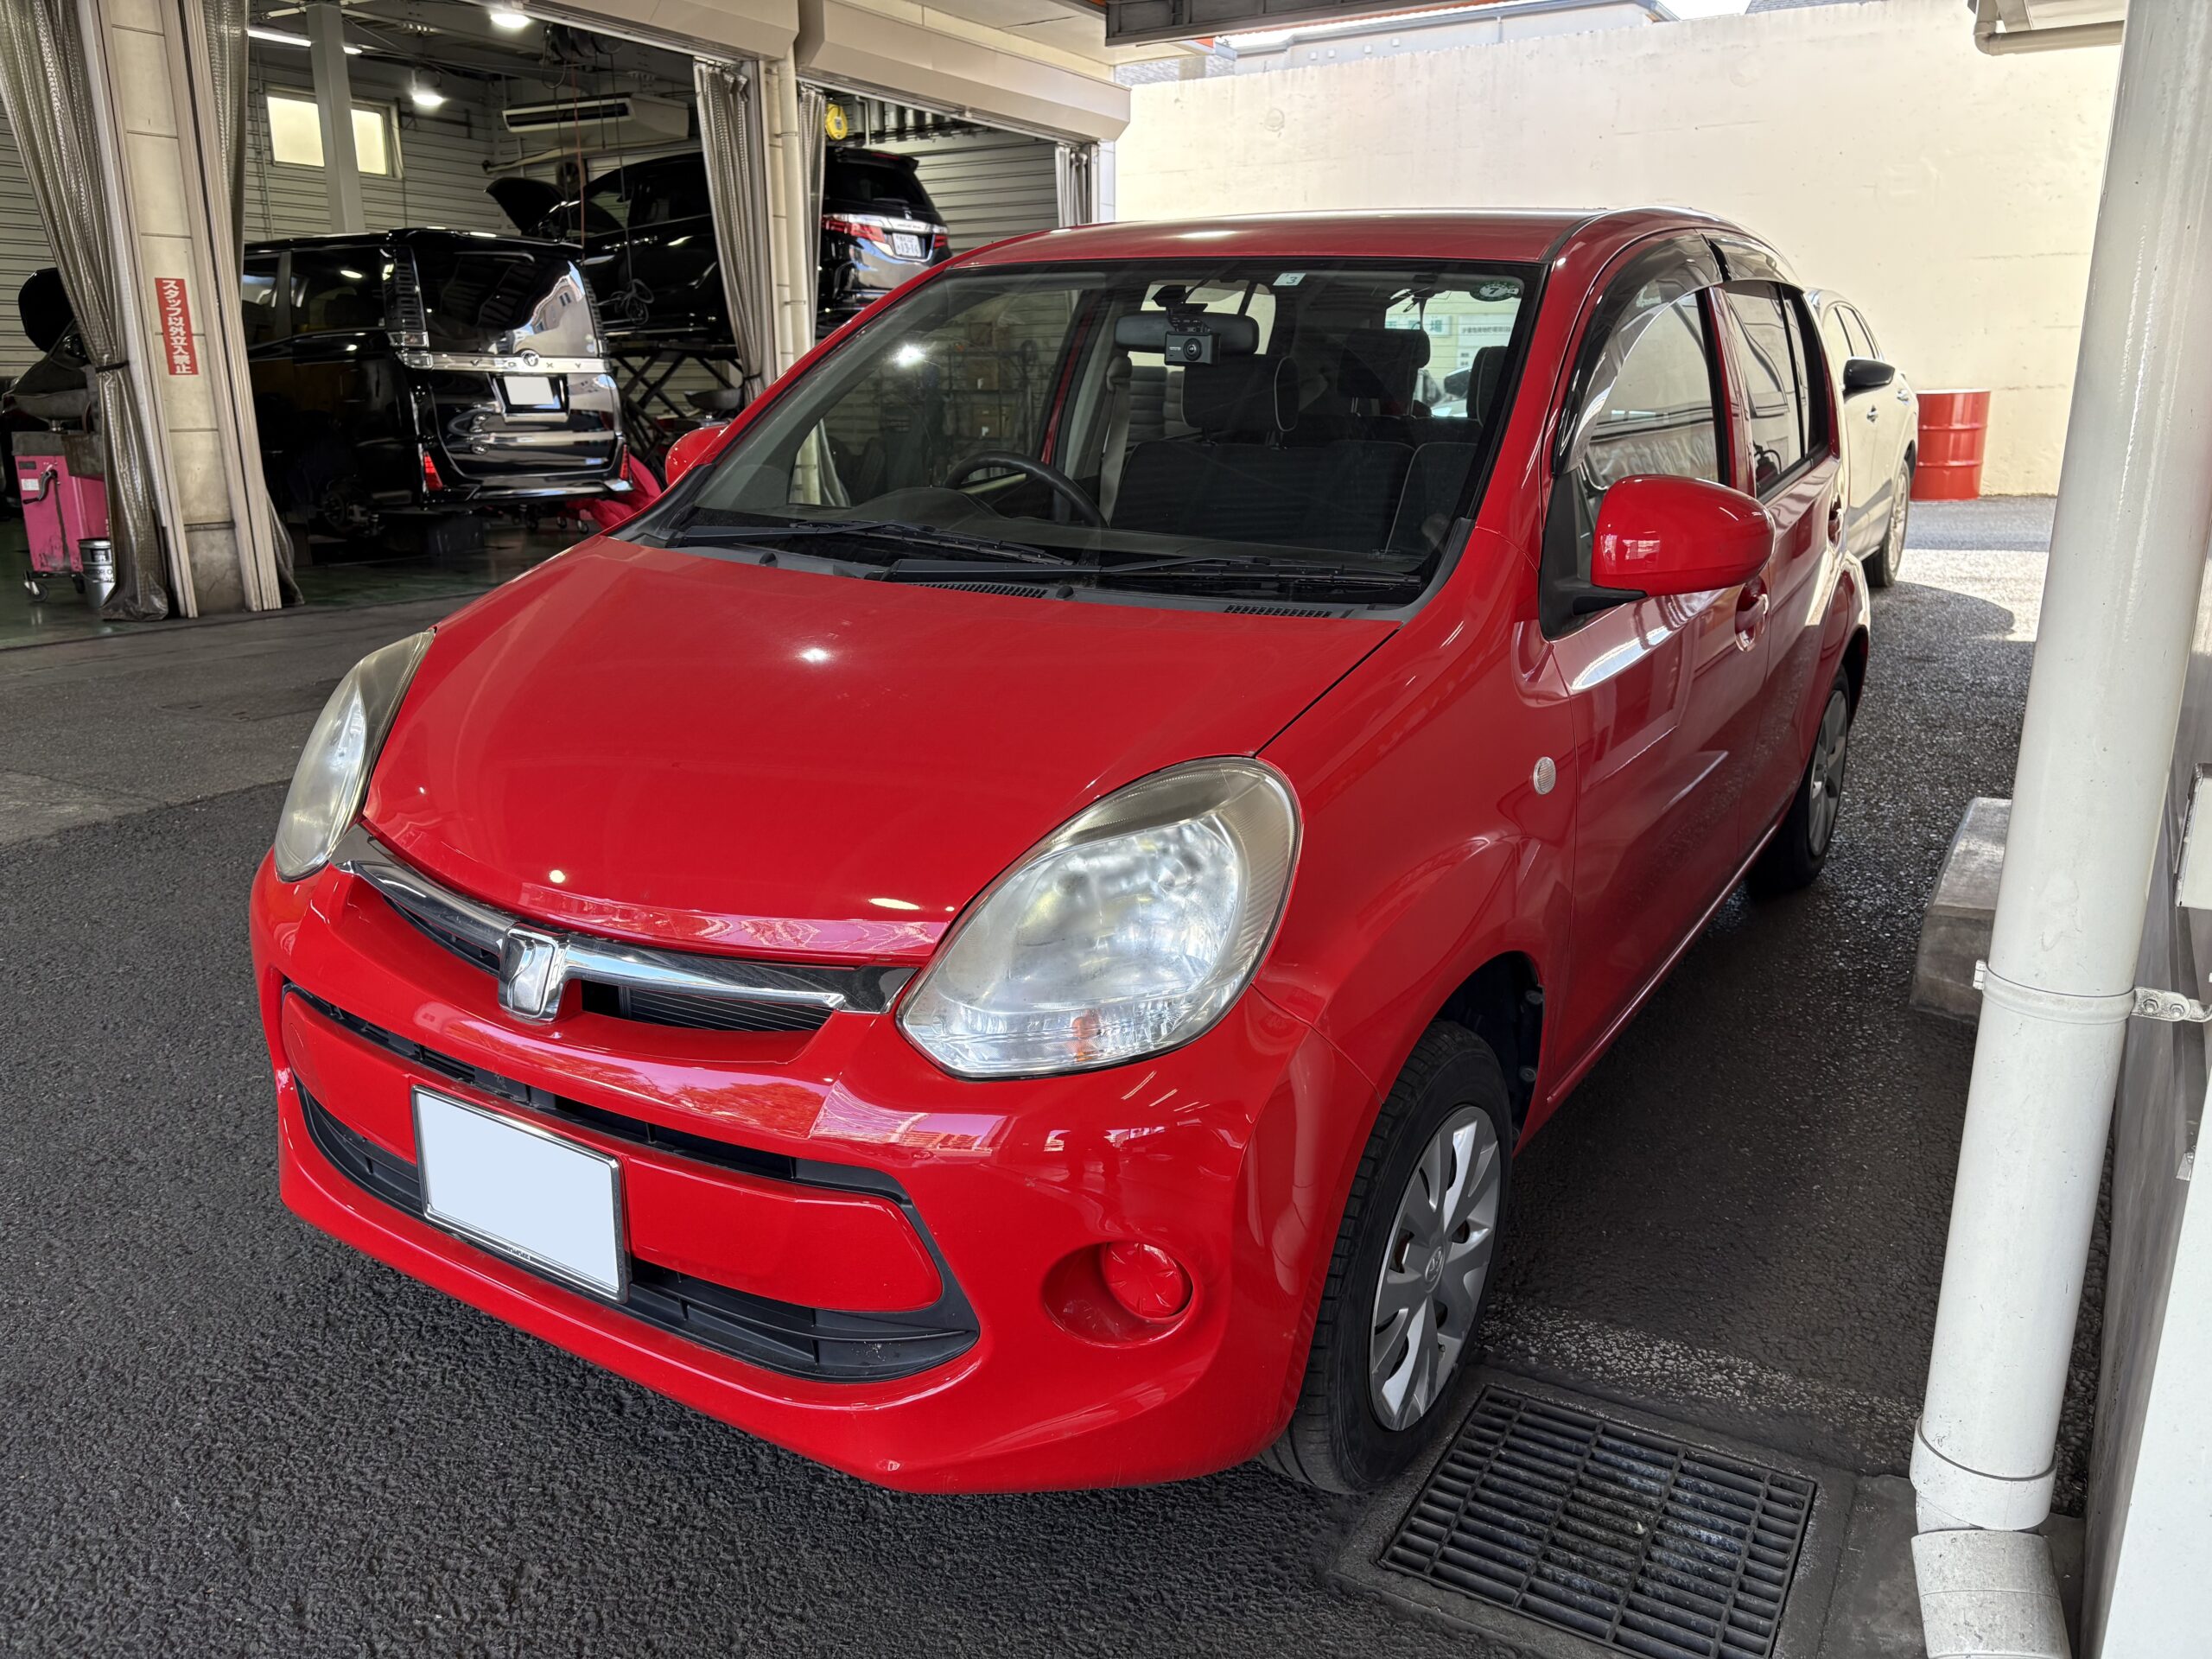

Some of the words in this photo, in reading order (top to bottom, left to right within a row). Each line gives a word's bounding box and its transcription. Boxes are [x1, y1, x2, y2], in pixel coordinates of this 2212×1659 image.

[162, 279, 193, 374] スタッフ以外立入禁止
[469, 358, 582, 368] VOXY
